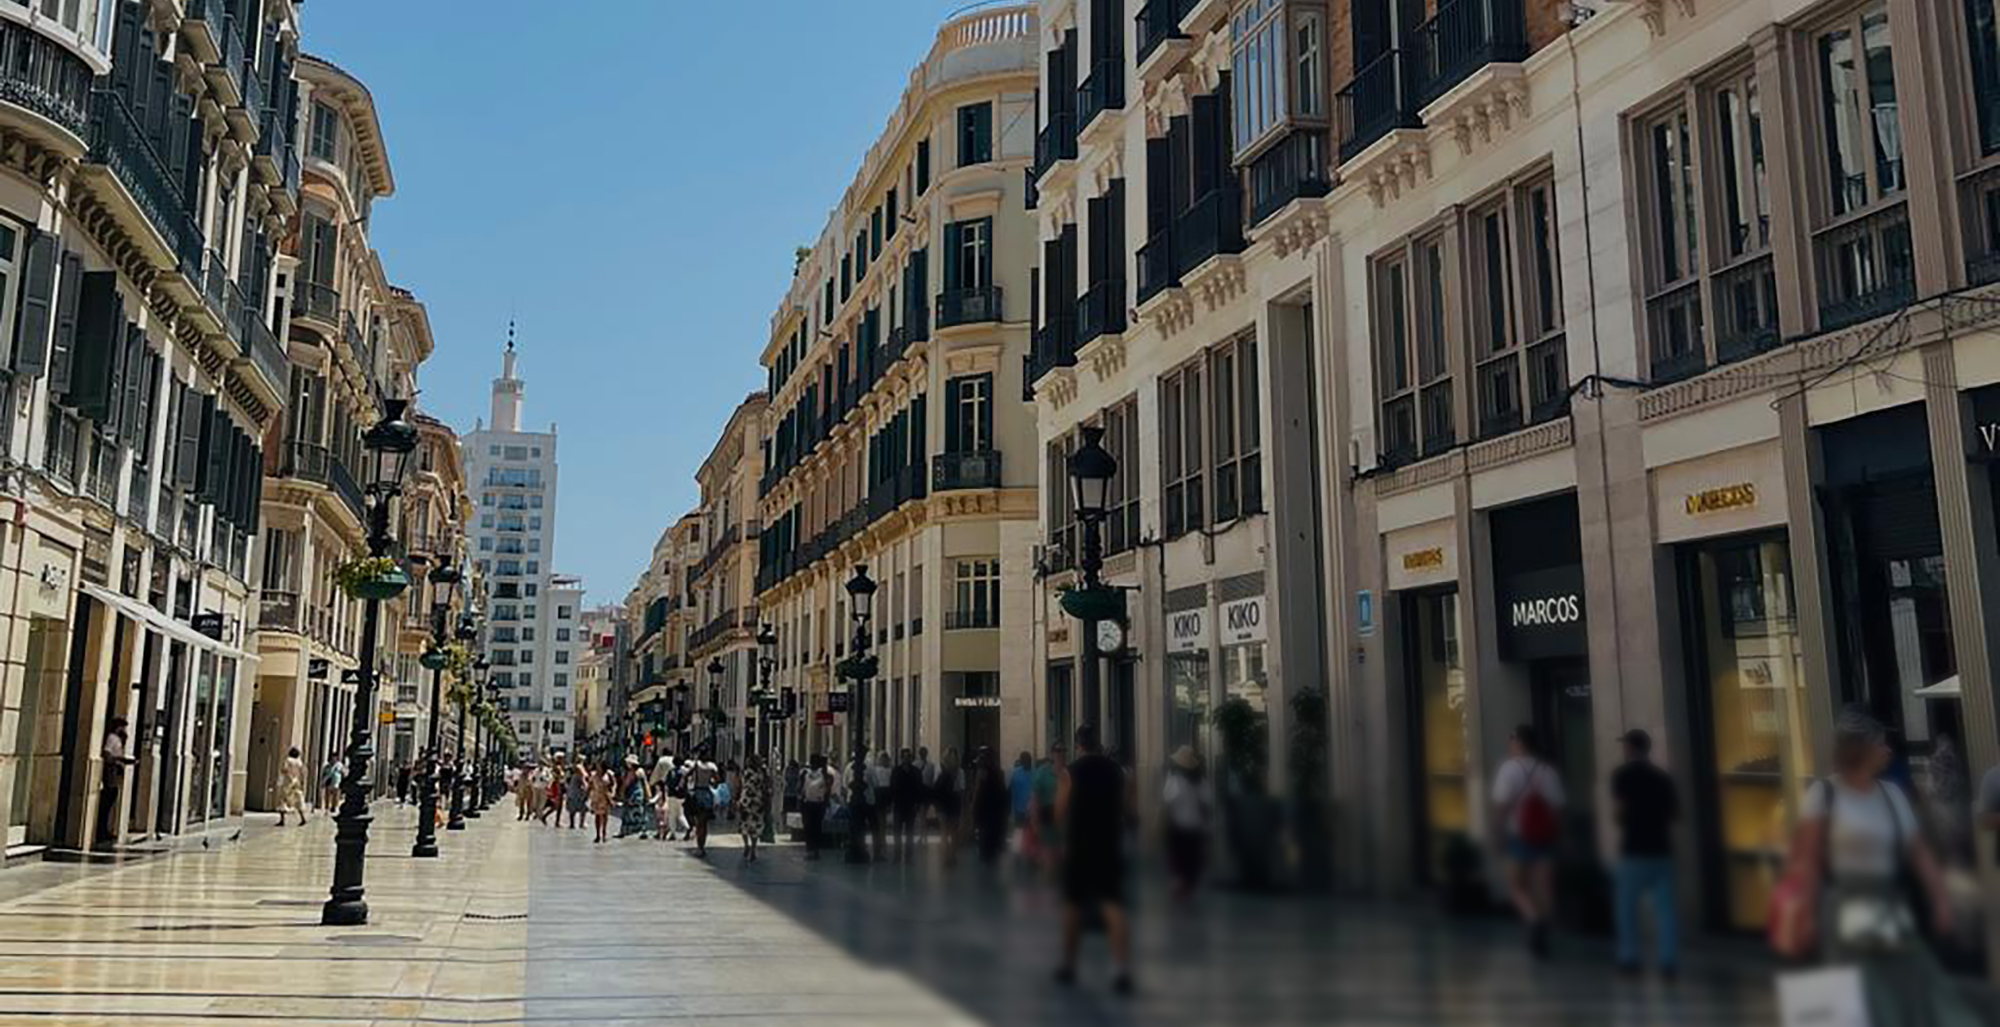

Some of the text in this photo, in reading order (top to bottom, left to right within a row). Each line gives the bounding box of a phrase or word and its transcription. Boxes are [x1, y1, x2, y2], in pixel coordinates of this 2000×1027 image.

[1227, 601, 1260, 630] KIKO
[1513, 594, 1579, 627] MARCOS
[1173, 613, 1200, 639] KIKO
